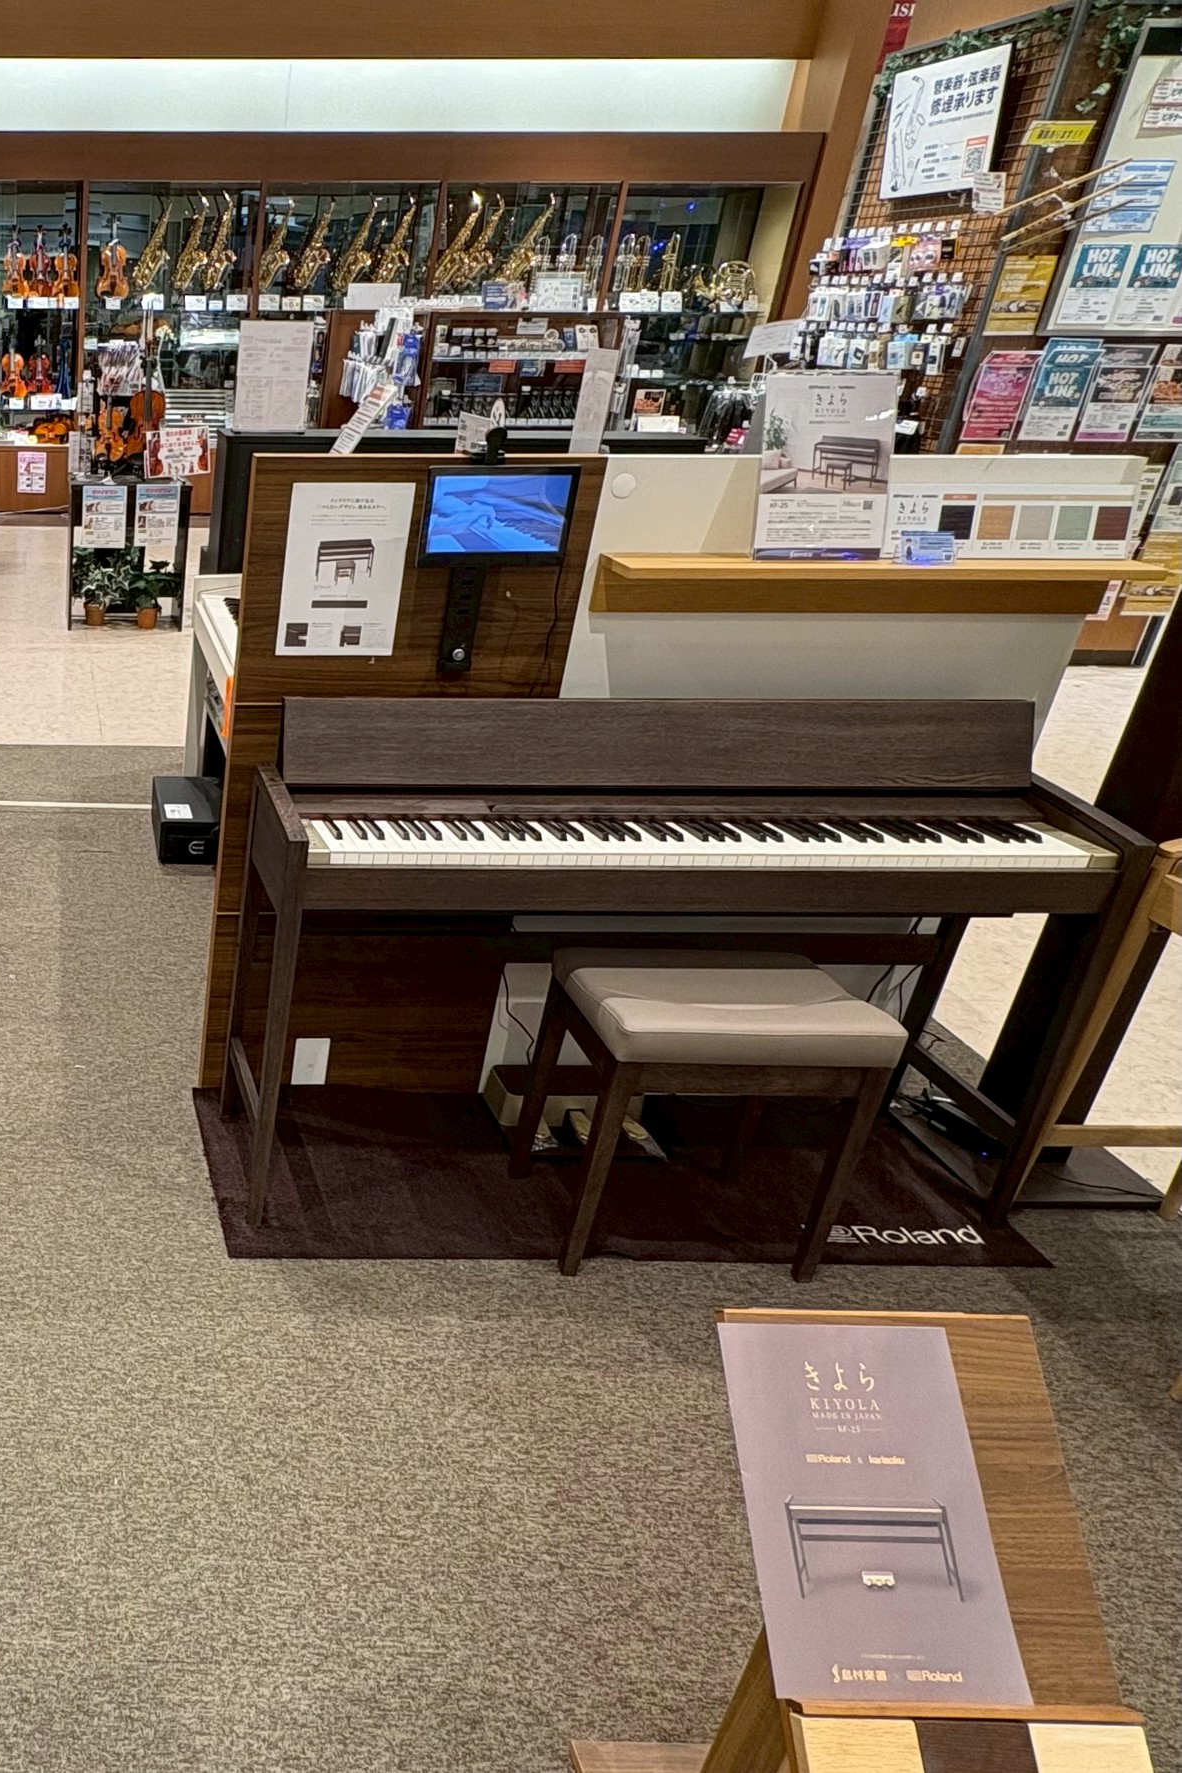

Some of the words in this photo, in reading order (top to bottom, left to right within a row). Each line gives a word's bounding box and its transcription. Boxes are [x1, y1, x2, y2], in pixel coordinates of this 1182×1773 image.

[930, 86, 998, 116] 修理承ります
[1086, 248, 1120, 264] HOT
[1144, 248, 1180, 264] HOT
[1049, 371, 1080, 386] HOT
[850, 1224, 986, 1245] Roland
[804, 1361, 875, 1392] きよら
[810, 1397, 880, 1411] KIYOLA
[854, 1412, 881, 1421] JAPAN
[818, 1454, 852, 1465] Roland
[921, 1669, 963, 1683] Roland
